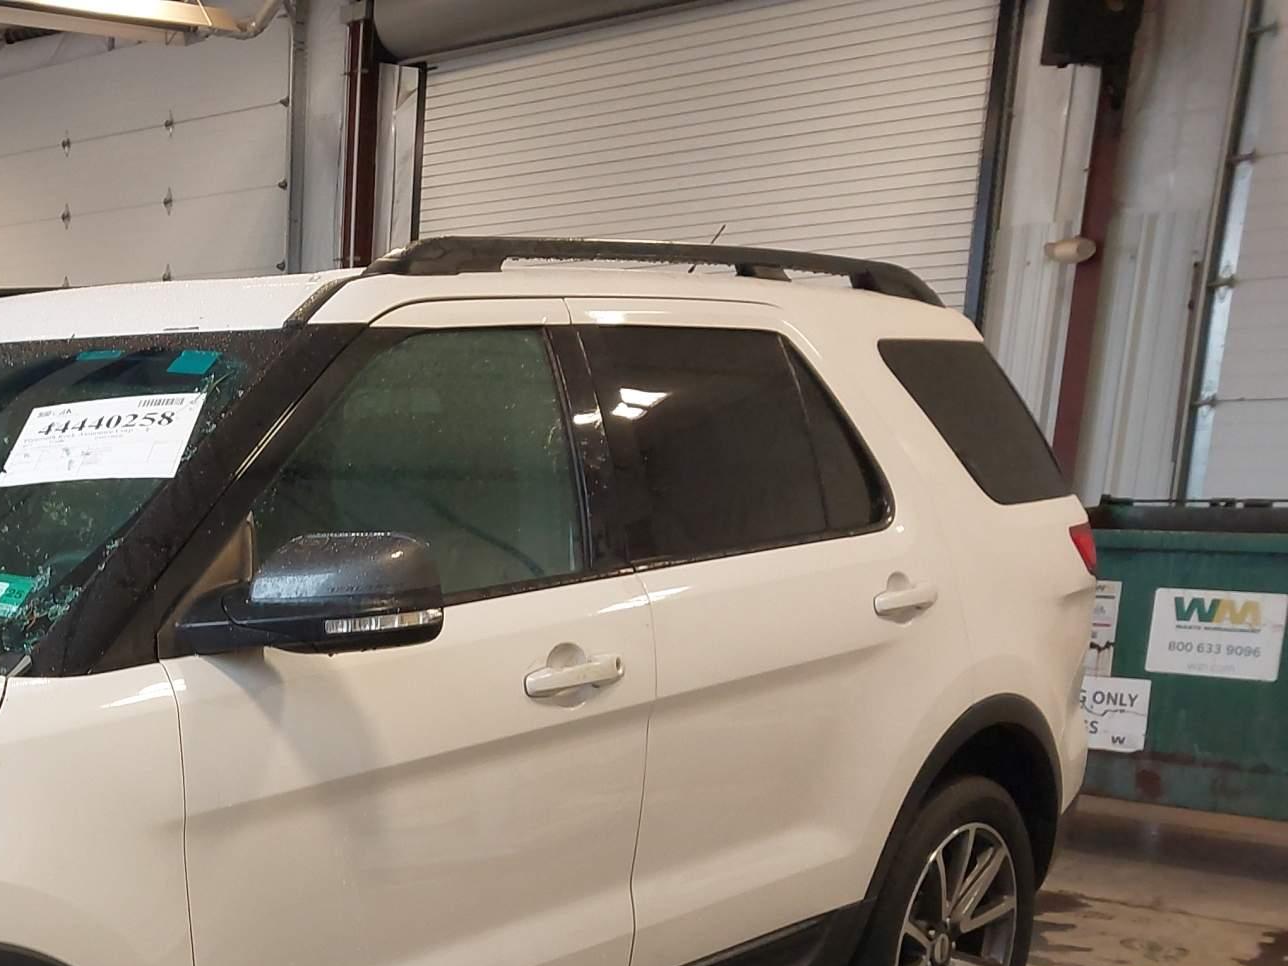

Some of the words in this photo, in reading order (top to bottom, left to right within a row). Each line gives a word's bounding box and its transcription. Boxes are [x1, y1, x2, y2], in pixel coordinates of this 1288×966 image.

[38, 410, 176, 436] 44440258
[1174, 596, 1262, 625] WM
[1168, 641, 1194, 653] 800
[1196, 642, 1222, 654] 633
[1092, 690, 1139, 708] ONLY
